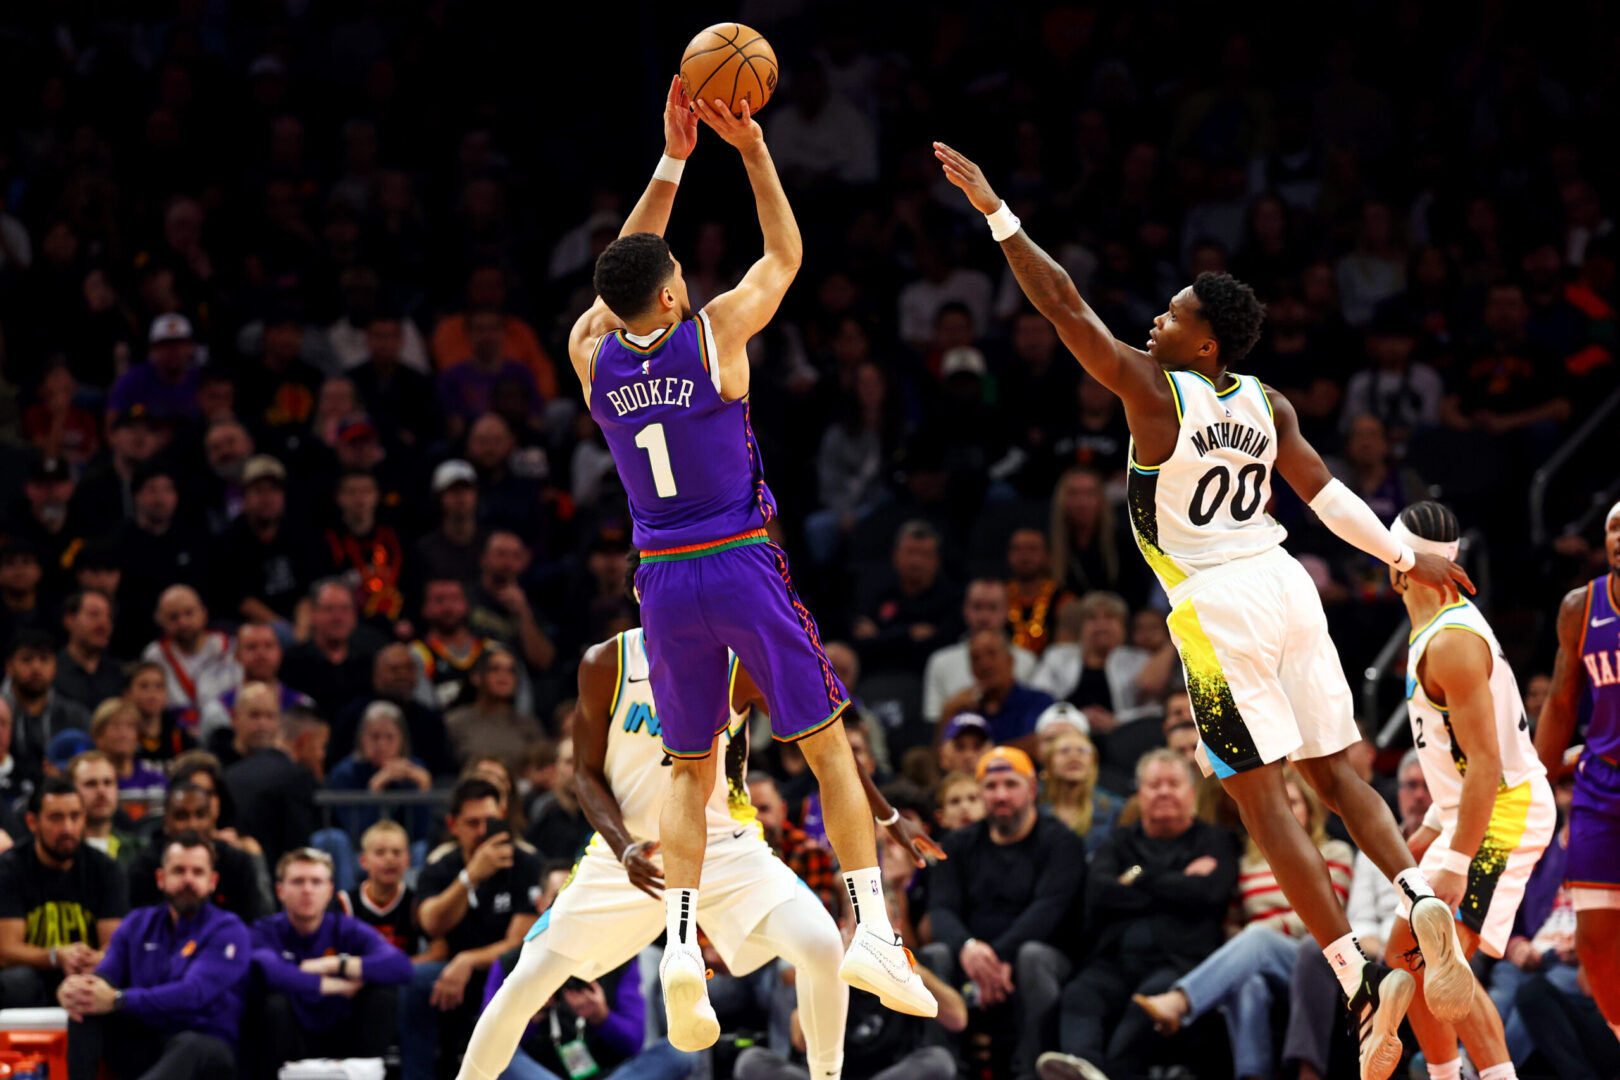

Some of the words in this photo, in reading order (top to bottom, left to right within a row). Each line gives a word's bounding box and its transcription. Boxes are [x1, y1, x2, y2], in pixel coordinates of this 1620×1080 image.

[606, 377, 695, 417] BOOKER
[634, 422, 678, 498] 1
[1190, 422, 1270, 458] MATHURIN
[1188, 463, 1267, 526] 00
[623, 701, 663, 736] IN
